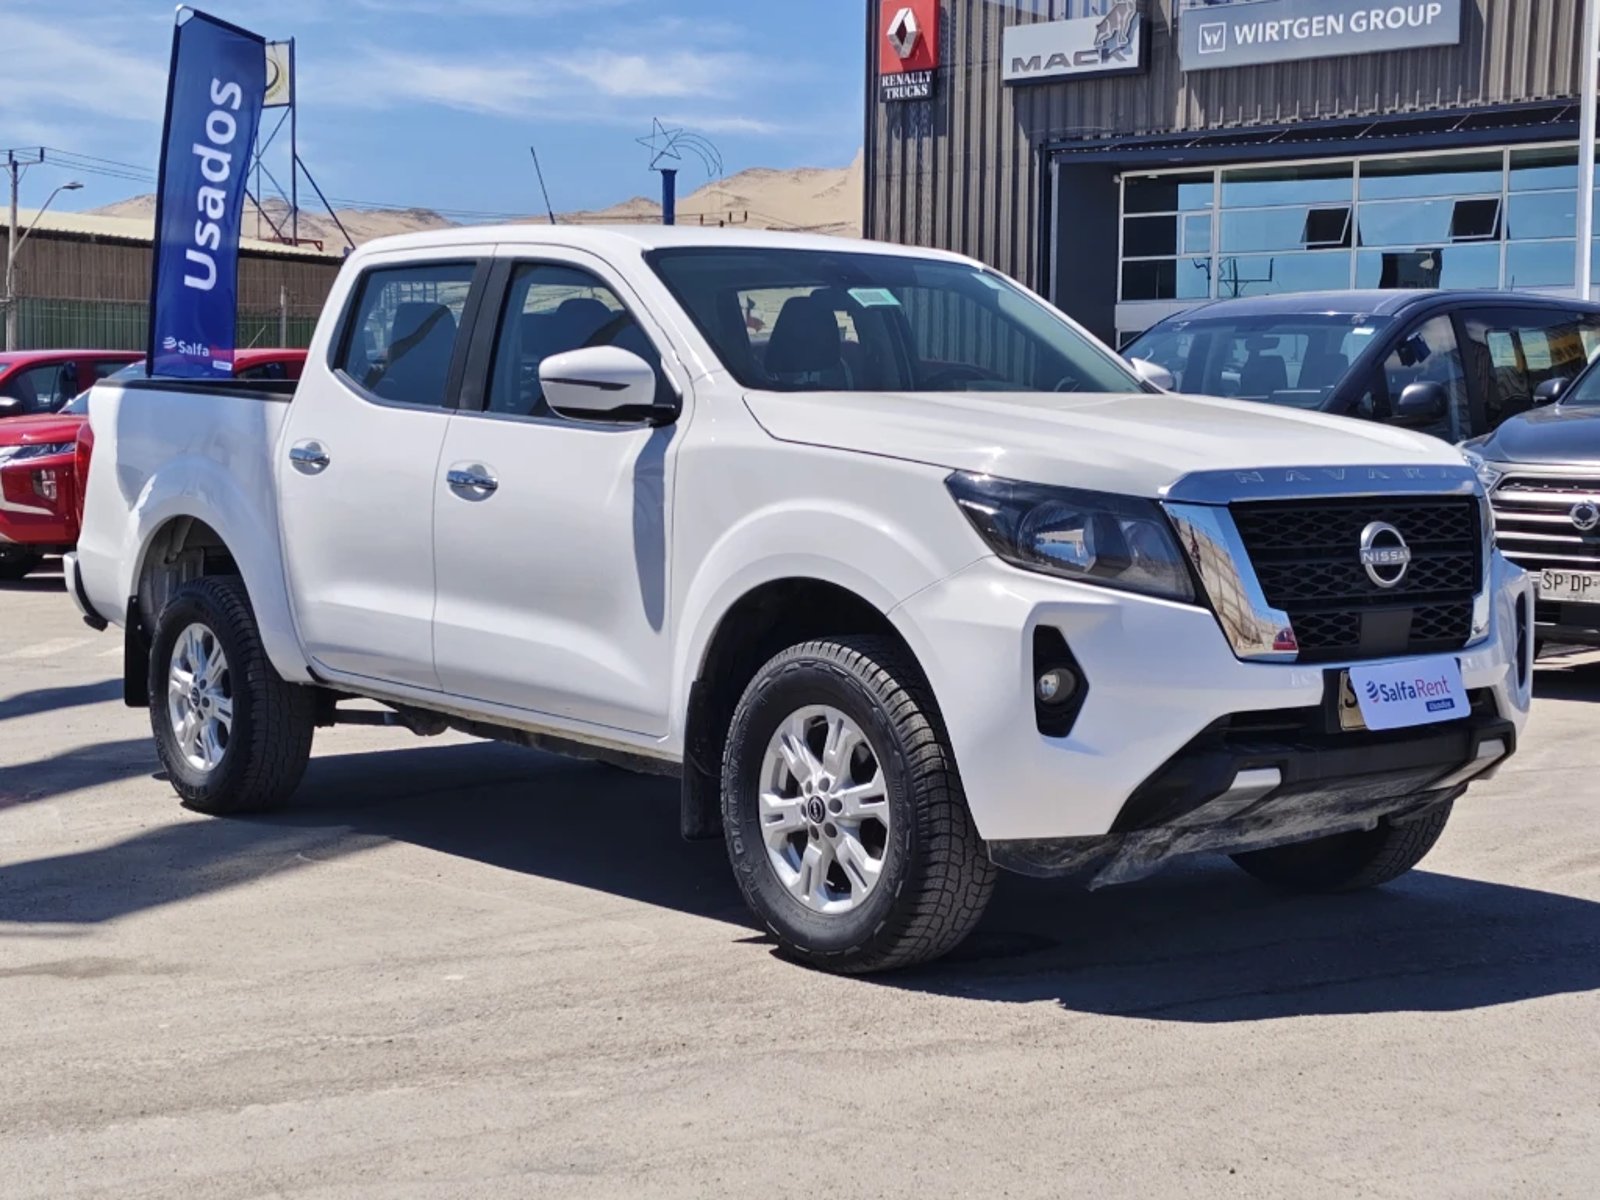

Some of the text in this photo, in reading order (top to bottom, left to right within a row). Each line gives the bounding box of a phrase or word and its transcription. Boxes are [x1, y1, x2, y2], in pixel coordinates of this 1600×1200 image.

[1234, 13, 1344, 45] WIRTGEN
[1350, 3, 1442, 33] GROUP
[1012, 46, 1127, 73] MACK
[882, 70, 932, 87] RENAULT
[884, 83, 928, 99] TRUCKS
[183, 77, 242, 291] Usados
[1233, 467, 1457, 484] NAVARA
[1363, 550, 1410, 562] NISSAN
[1379, 675, 1451, 703] SalfaRent
